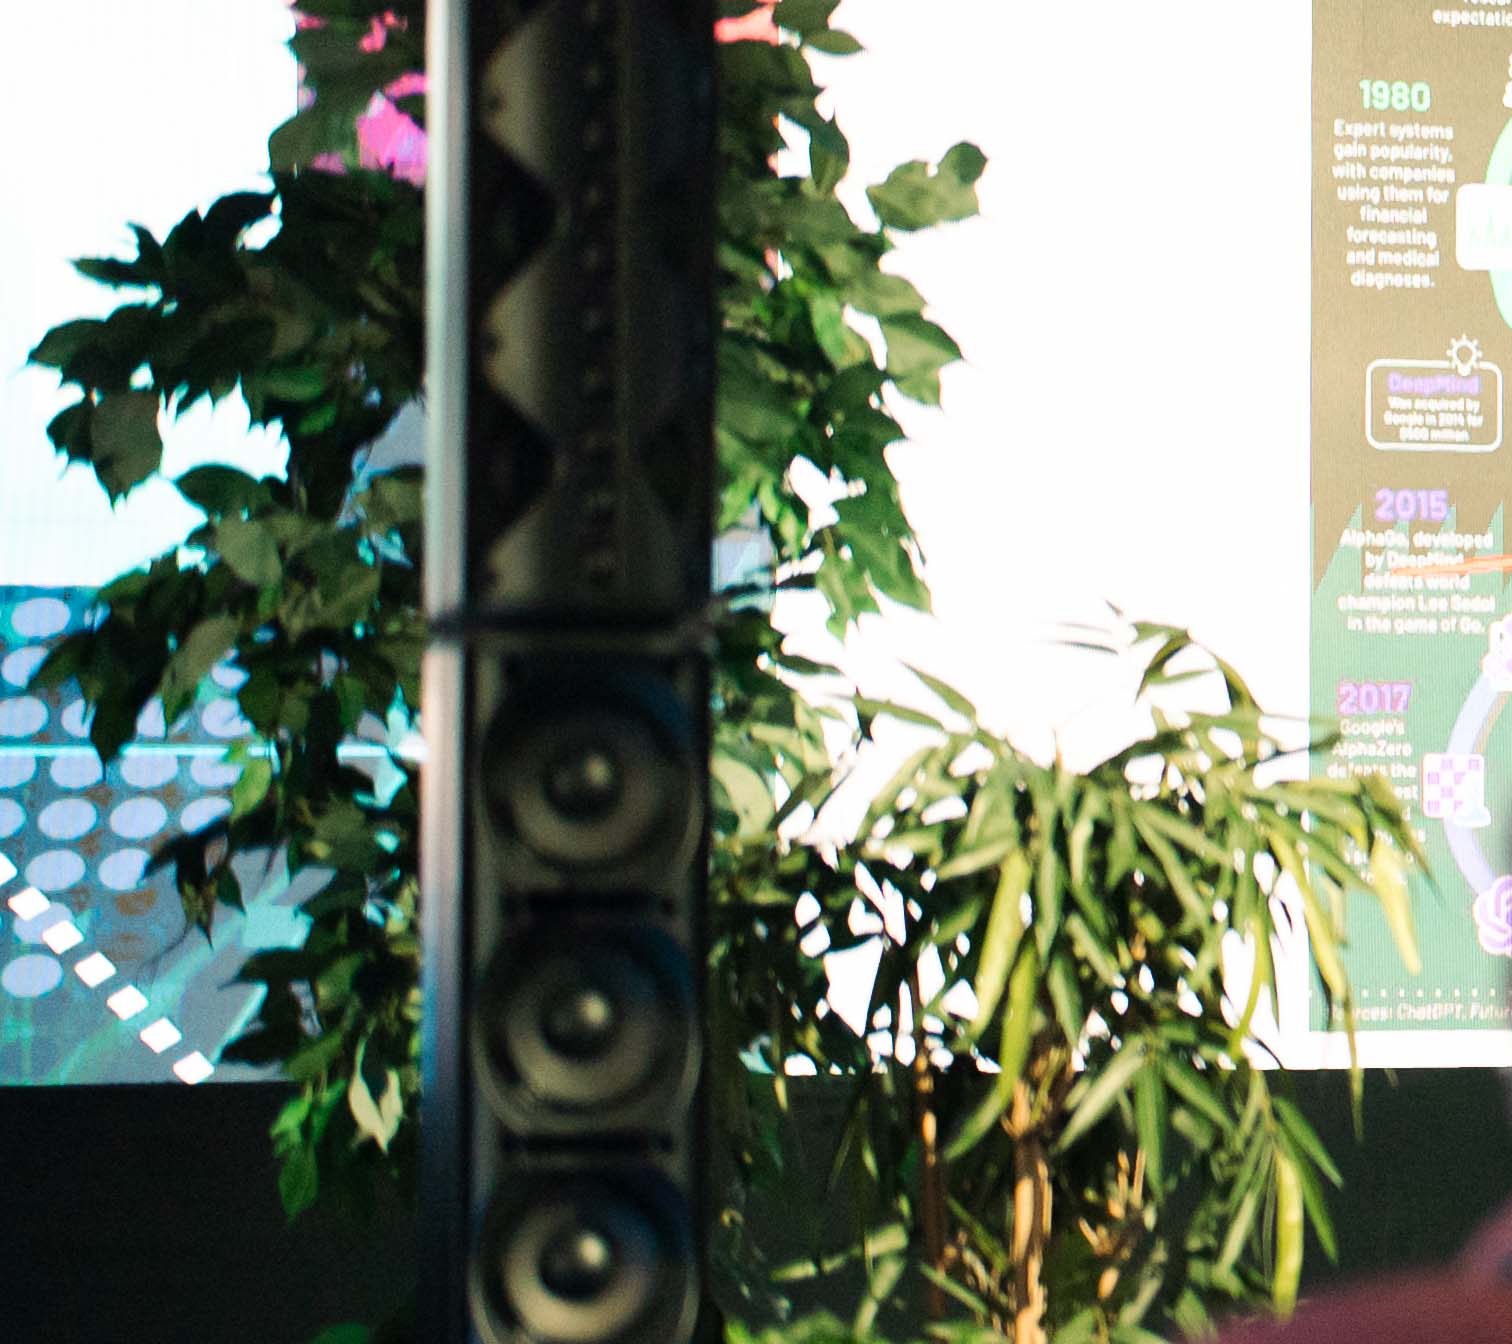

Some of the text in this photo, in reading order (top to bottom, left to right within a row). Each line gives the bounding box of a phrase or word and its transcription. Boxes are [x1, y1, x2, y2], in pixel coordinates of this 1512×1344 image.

[1359, 78, 1432, 113] 1980
[1374, 488, 1449, 522] 2015
[1337, 681, 1412, 715] 2017
